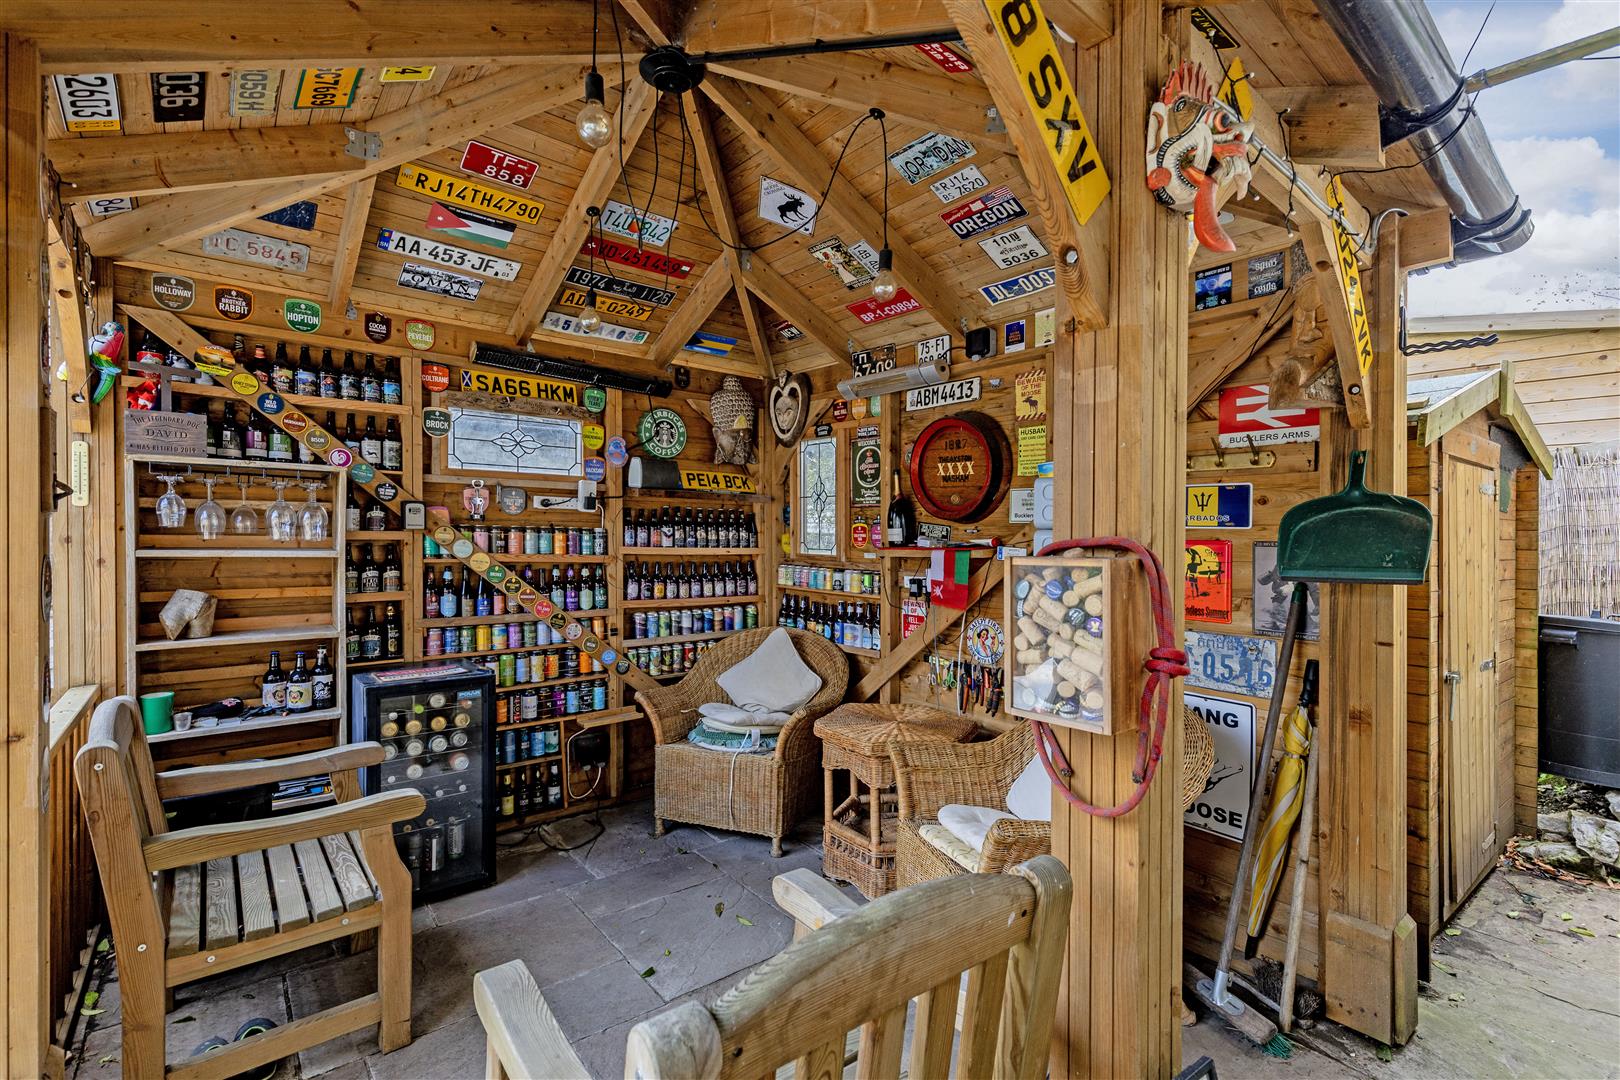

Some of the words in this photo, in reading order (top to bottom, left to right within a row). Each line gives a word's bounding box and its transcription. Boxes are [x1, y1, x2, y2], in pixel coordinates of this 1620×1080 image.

[1028, 54, 1097, 183] SXV
[484, 165, 524, 186] 858
[955, 177, 985, 197] 7620
[415, 172, 540, 220] RJ14TH4790
[953, 199, 1021, 235] OREGON
[1002, 249, 1039, 267] 5036
[411, 273, 470, 294] OMAN
[154, 285, 192, 297] HOLLOWAY
[219, 303, 249, 315] RABBIT
[221, 298, 246, 307] BROTHER
[287, 312, 319, 325] HOPTON
[368, 322, 386, 331] COCOA
[421, 374, 449, 384] COLTRANE
[1017, 376, 1046, 386] BEWARE
[476, 375, 531, 398] SA66
[537, 382, 575, 403] HKM
[1030, 382, 1042, 390] THE
[916, 380, 973, 407] ABM4413
[1021, 389, 1042, 397] MOOSE
[132, 417, 146, 425] THE
[147, 416, 184, 425] LEGENDARY
[425, 420, 449, 429] BROCK
[645, 409, 685, 433] STARBUCKS
[145, 429, 188, 439] DAVID
[180, 446, 197, 454] 2019
[648, 442, 682, 456] COFFEE
[937, 461, 975, 476] XXXX
[722, 475, 750, 490] BCK
